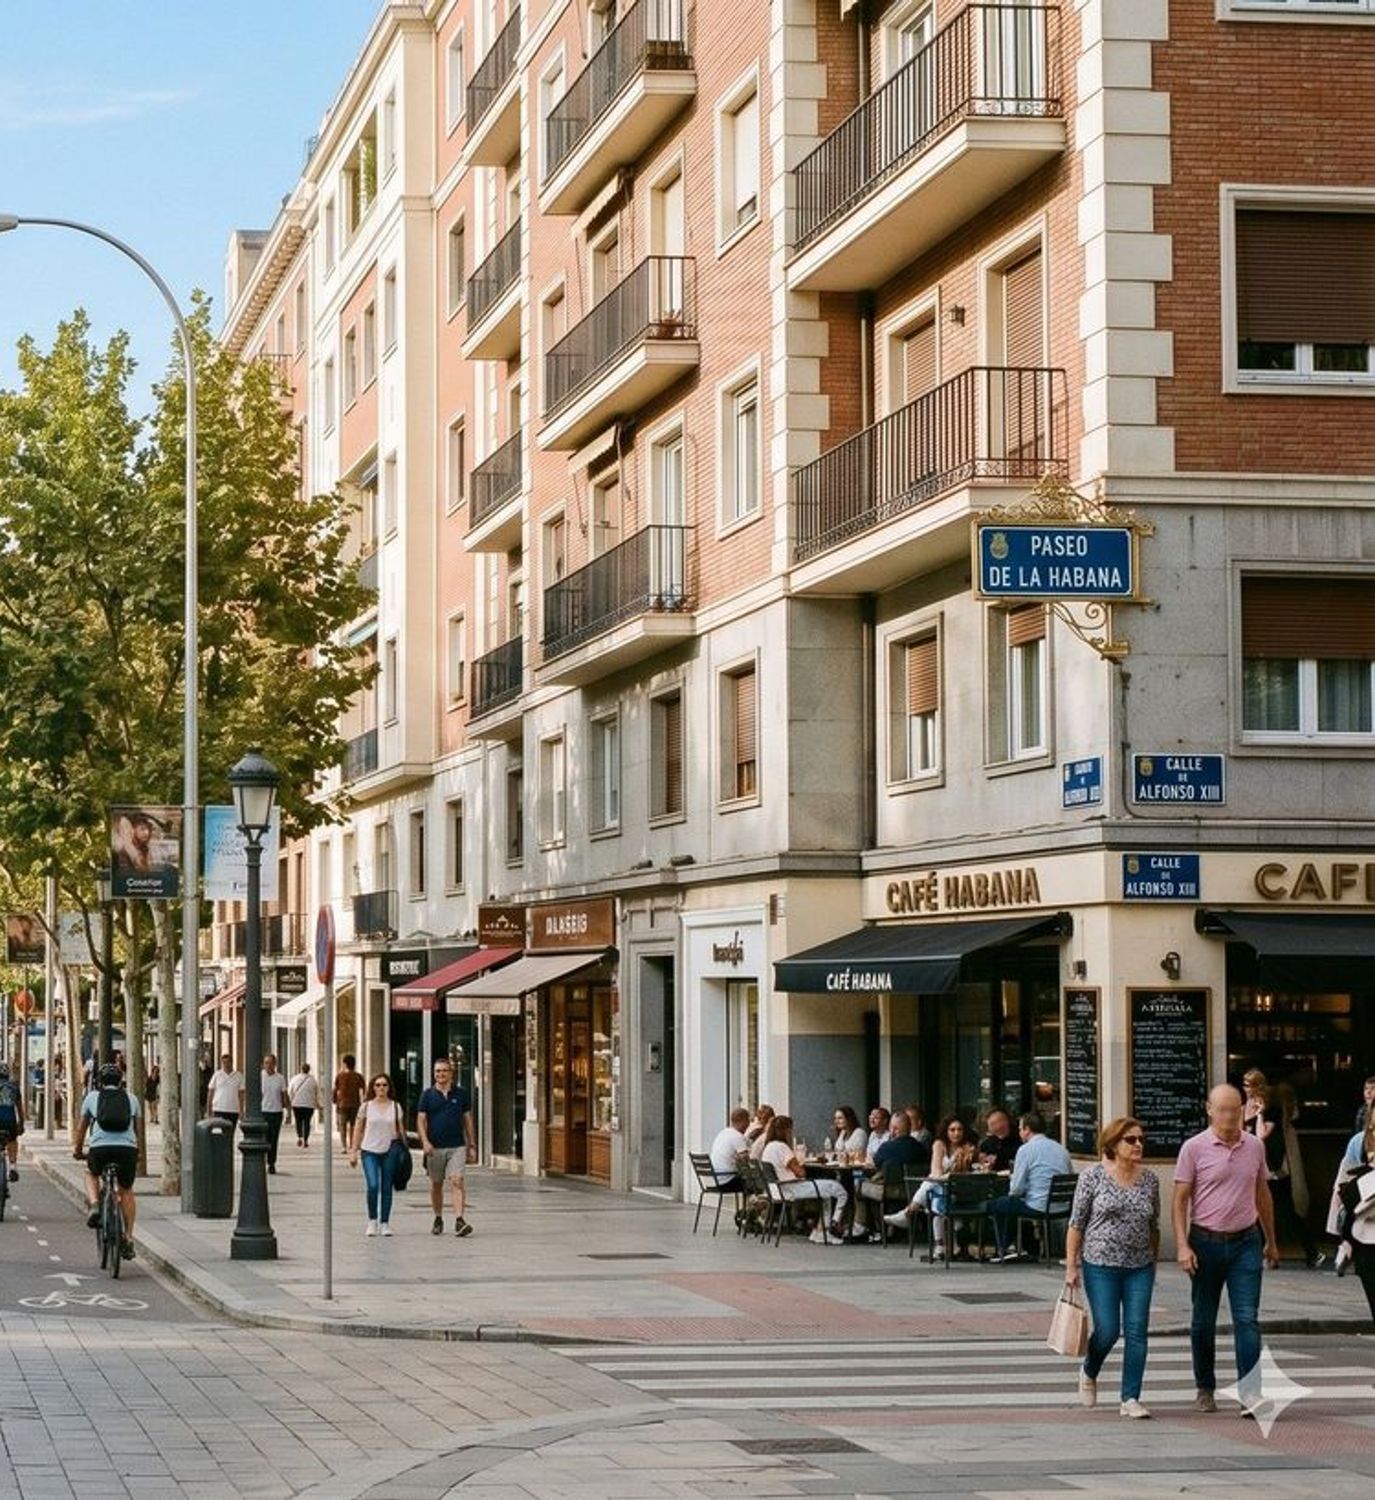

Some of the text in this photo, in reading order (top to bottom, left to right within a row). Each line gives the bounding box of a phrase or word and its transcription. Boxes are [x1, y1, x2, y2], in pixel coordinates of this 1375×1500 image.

[1031, 535, 1088, 556] PASEO
[989, 566, 1122, 588] DE LA HABANA
[1165, 757, 1203, 771] CALLE
[1138, 784, 1195, 800] ALFONSO
[1150, 857, 1181, 869] CALLE
[886, 867, 1042, 914] CAFÉ HABANA
[1125, 881, 1175, 896] ALFONSO
[826, 966, 892, 990] CAFÉ HABANA
